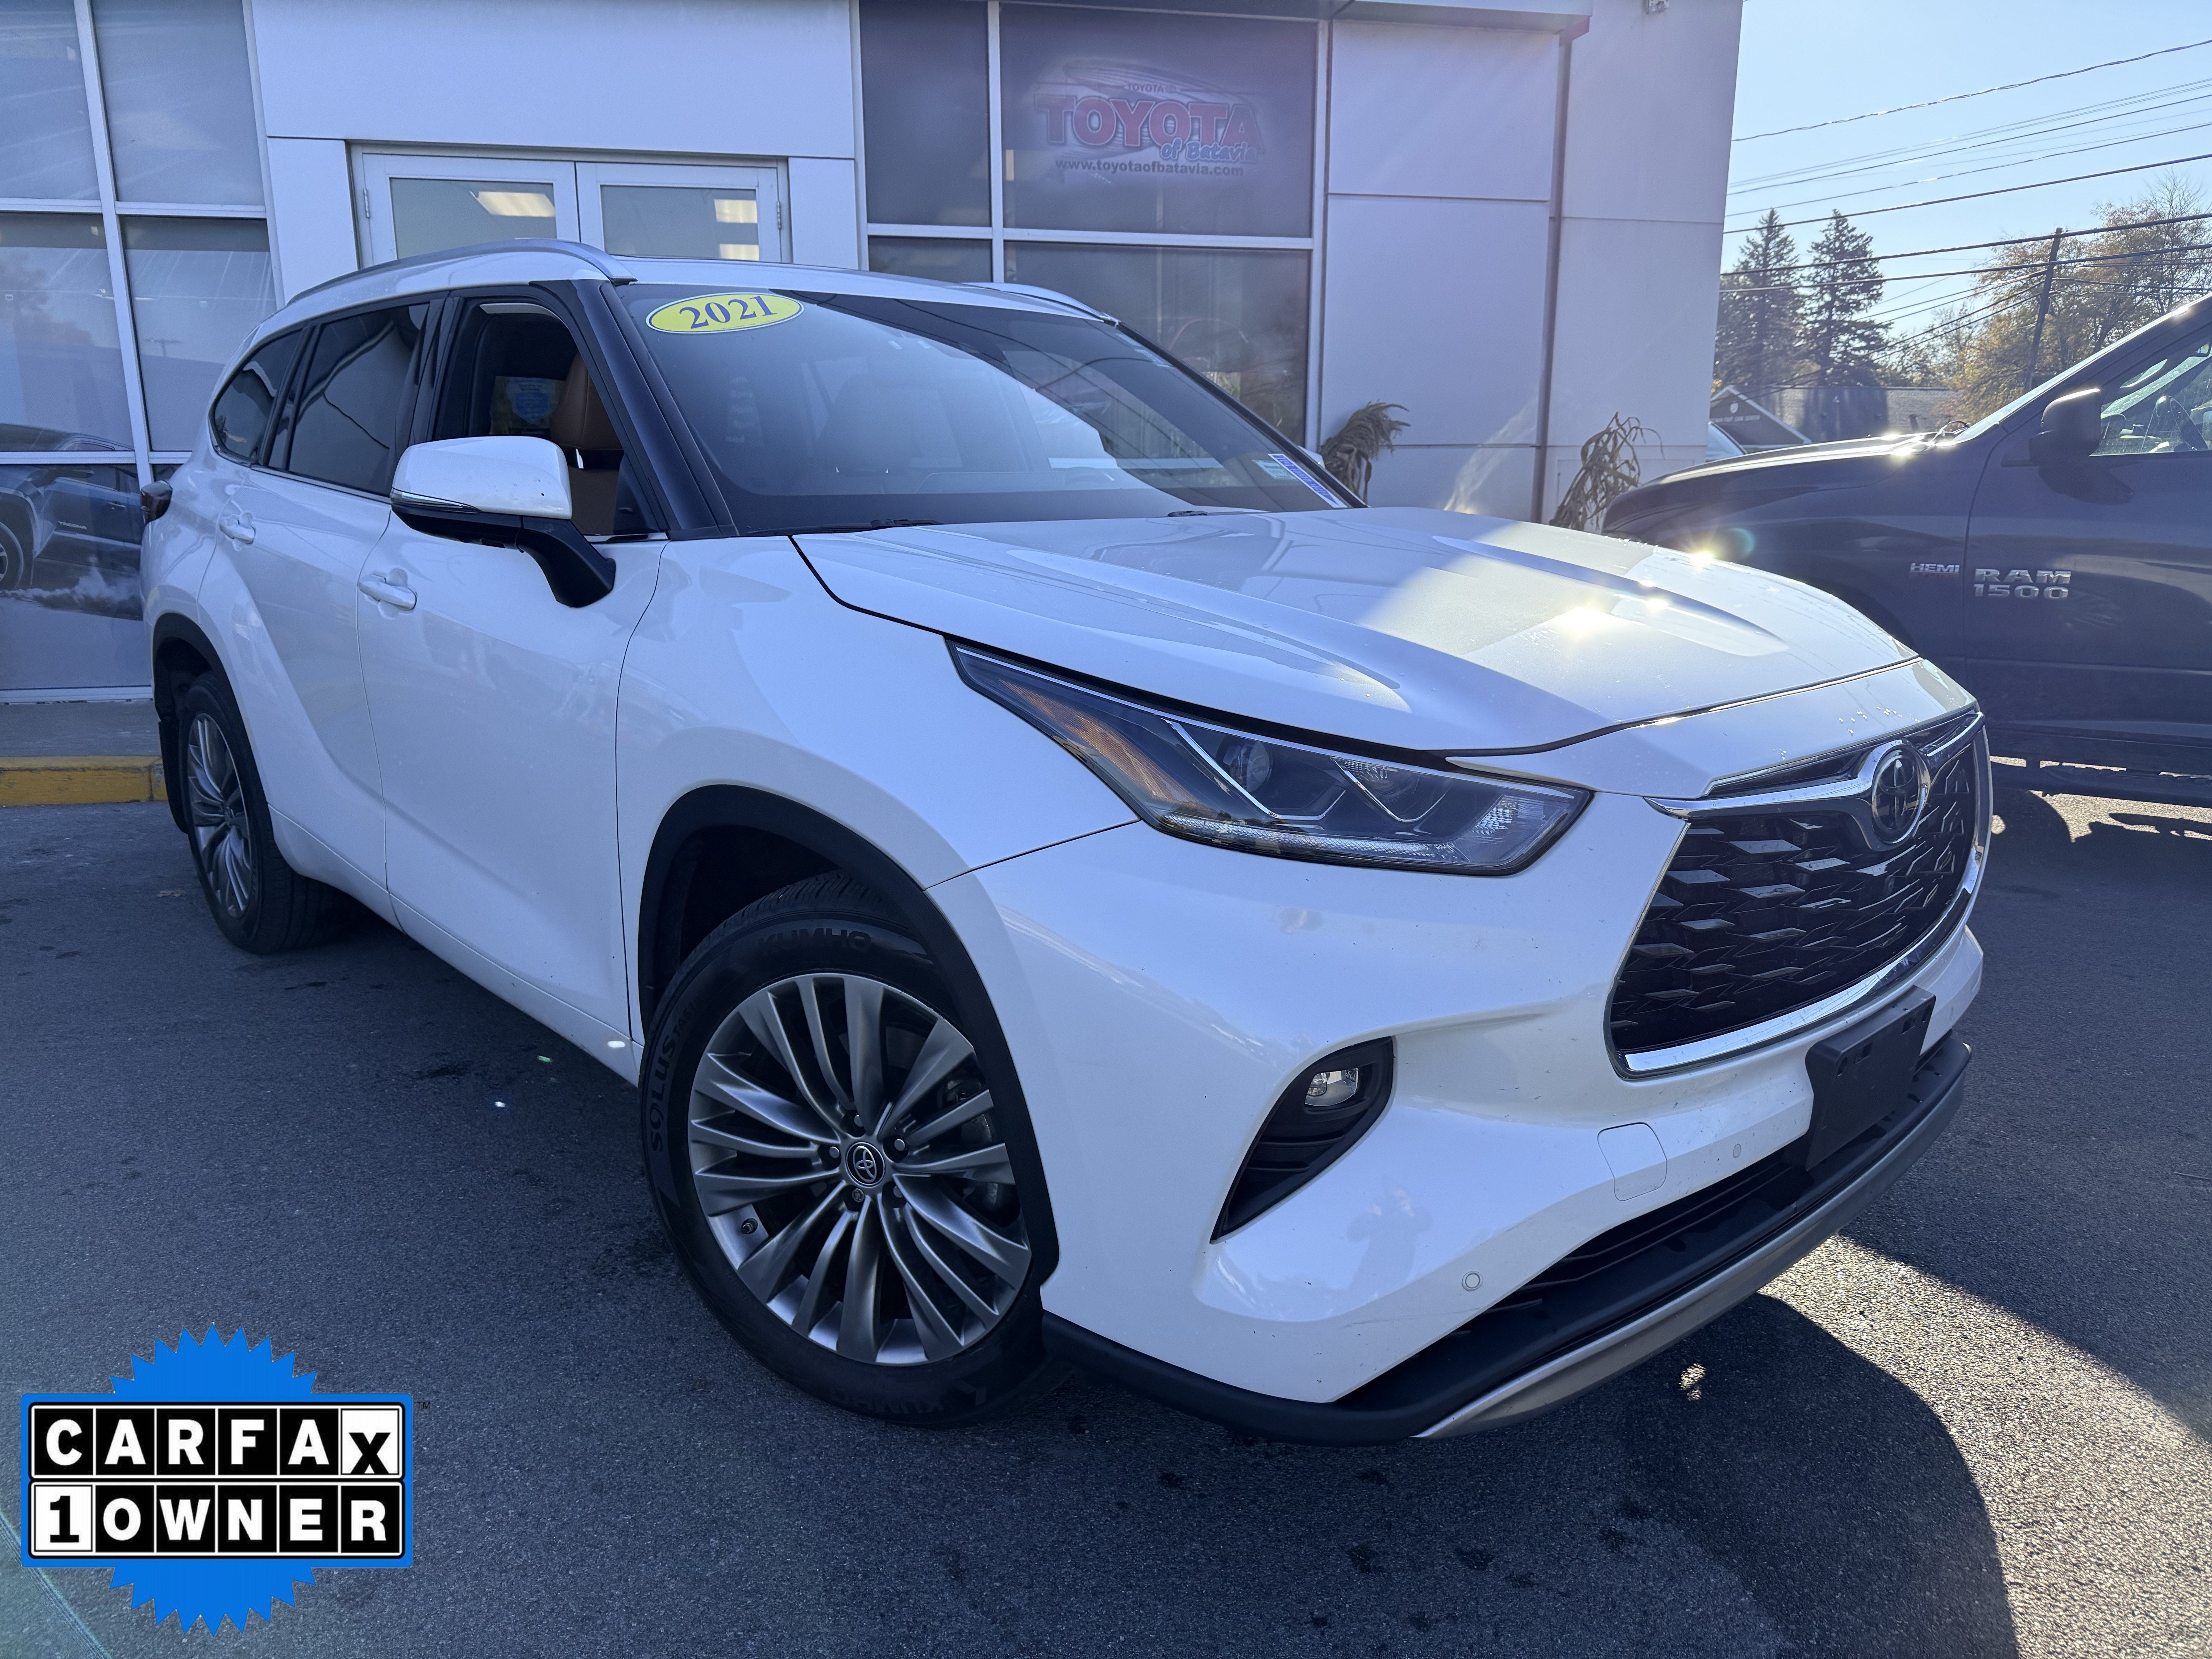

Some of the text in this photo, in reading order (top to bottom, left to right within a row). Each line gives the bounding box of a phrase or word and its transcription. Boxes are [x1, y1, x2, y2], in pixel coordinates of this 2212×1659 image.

[1127, 83, 1164, 93] TOYOTA
[1035, 95, 1261, 149] TOYOTA
[1160, 138, 1257, 163] of Batavia
[1055, 159, 1244, 177] www.toyotaofbatavia.com
[679, 295, 778, 329] 2021
[1910, 563, 1960, 573] HEMI
[1975, 568, 2071, 584] RAM
[1974, 584, 2069, 599] 1500
[757, 928, 871, 955] KUMHO
[649, 1035, 675, 1152] SOLUS
